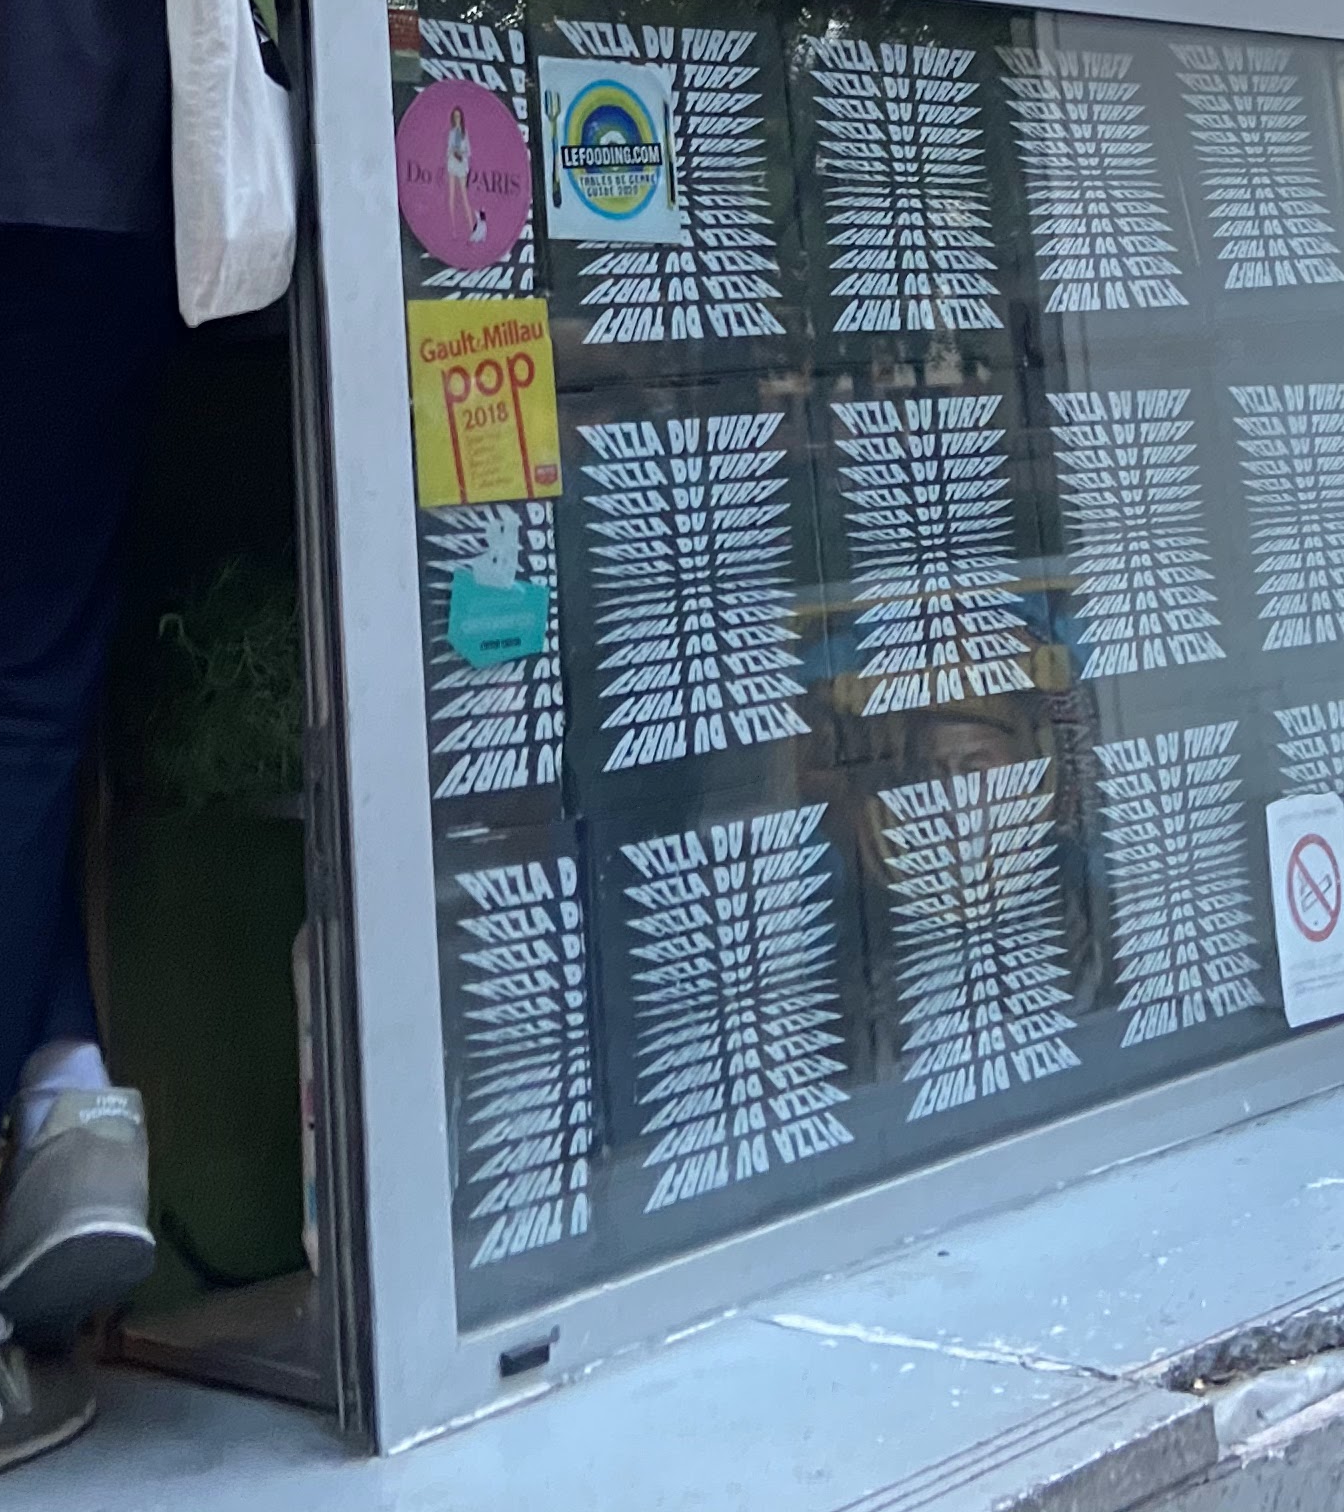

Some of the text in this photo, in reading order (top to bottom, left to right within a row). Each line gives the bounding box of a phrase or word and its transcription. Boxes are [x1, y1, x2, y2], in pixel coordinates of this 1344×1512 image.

[509, 30, 526, 64] D
[556, 19, 756, 61] PIZZA DU TURFU
[806, 36, 976, 77] PIZZA DU TURFU
[683, 63, 759, 87] TURFU
[995, 46, 1134, 79] PIZZA DU TURFU
[809, 71, 978, 101] PIZZA DU TURFU
[1001, 76, 1139, 100] PIZZA DU TURFU
[564, 145, 660, 166] LEFOODING.COM
[466, 168, 521, 195] PARIS
[463, 401, 509, 430] 2018
[830, 395, 1002, 433] PIZZA DU TURFU
[1046, 389, 1191, 421] PIZZA DU TURFU
[1229, 385, 1284, 413] PIZZA
[1283, 385, 1306, 411] DU
[576, 412, 785, 459] PIZZA DU TURFU
[1050, 420, 1194, 446] PIZZA DU TURFU
[1233, 416, 1287, 436] PIZZA
[1287, 415, 1308, 434] DU
[834, 429, 1005, 461] PIZZA DU TURFU
[580, 460, 667, 489] PIZZA
[669, 456, 702, 483] DU
[709, 450, 787, 480] TURFU
[1274, 704, 1328, 737] PIZZA
[1092, 720, 1239, 774] PIZZA DU TURFU
[1277, 735, 1330, 761] PIZZA
[877, 756, 1051, 821] PIZZA DU TURFU
[1096, 754, 1241, 800] PIZZA DU TURFU
[881, 792, 1053, 849] PIZZA DU TURFU
[620, 802, 828, 878] PIZZA DU TURFU
[455, 857, 577, 910] PIZZA D
[623, 842, 830, 909] PIZZA DU TURFU
